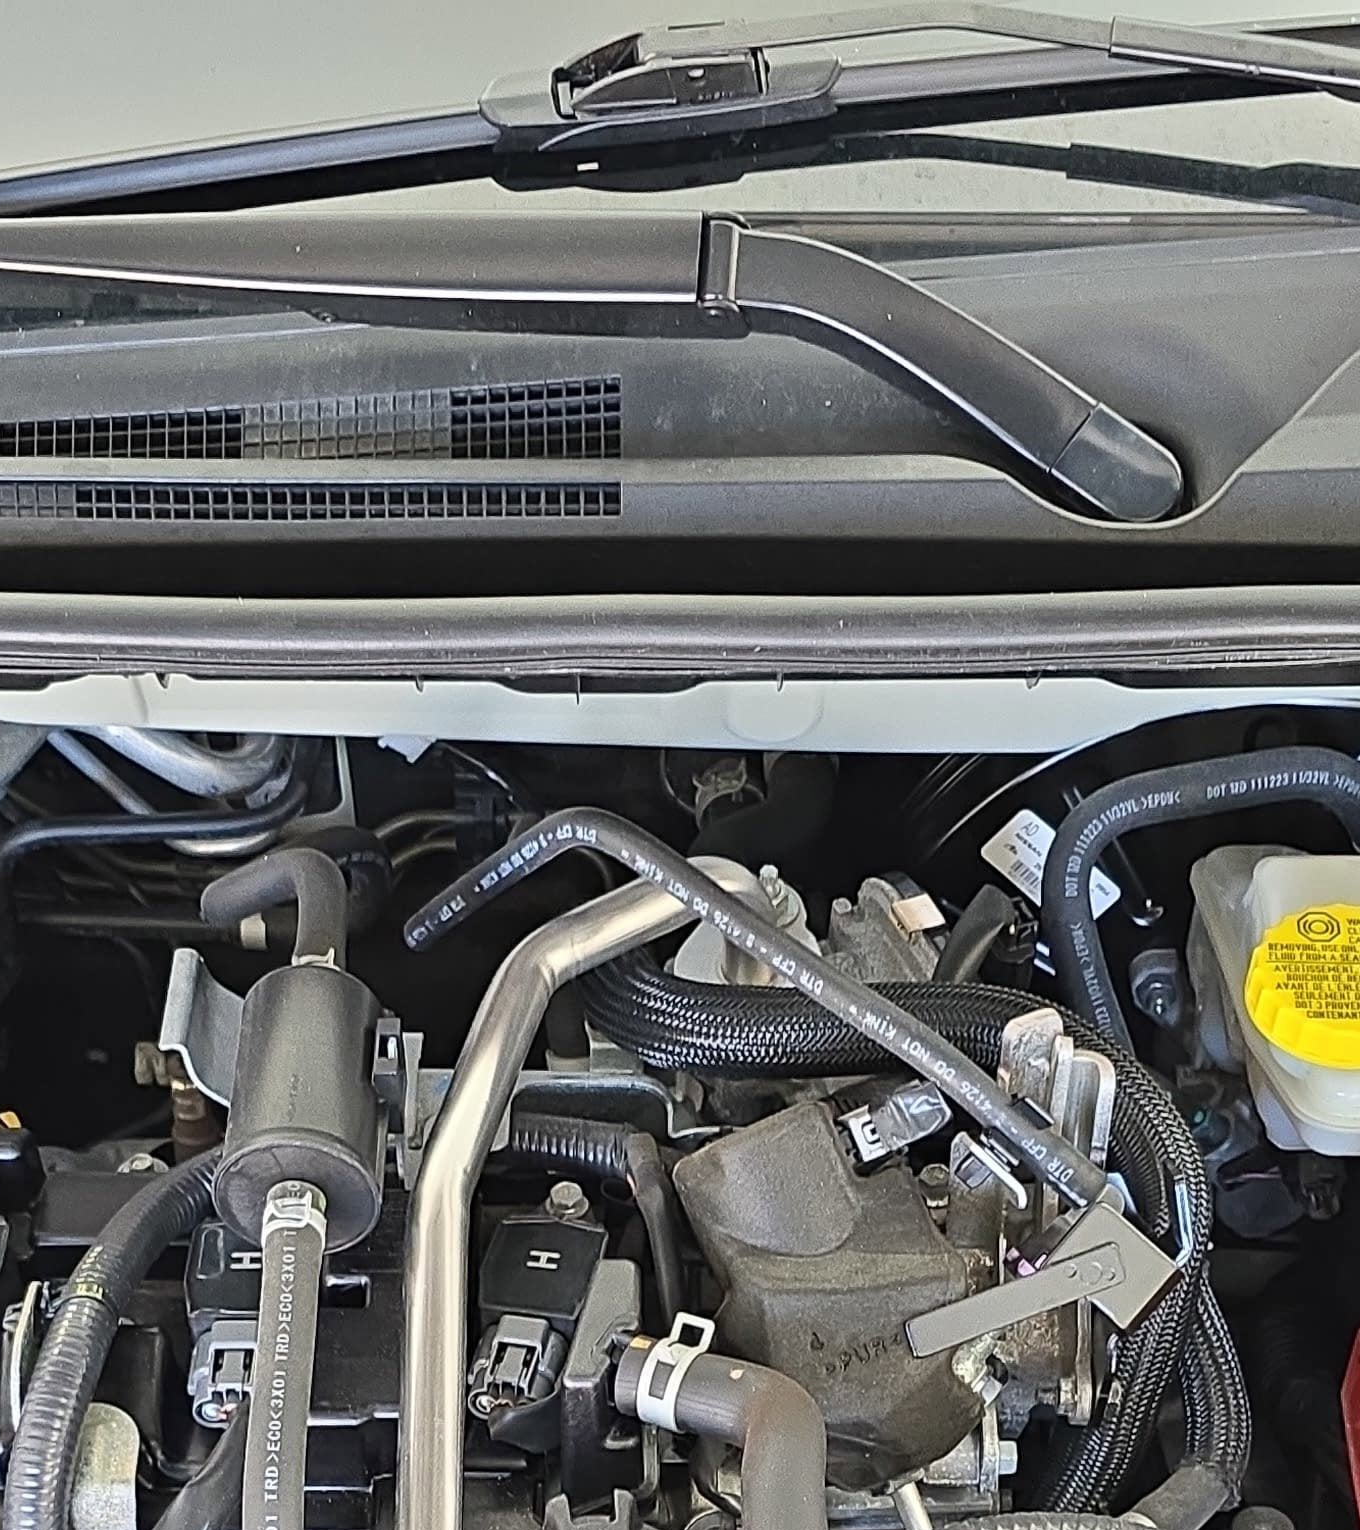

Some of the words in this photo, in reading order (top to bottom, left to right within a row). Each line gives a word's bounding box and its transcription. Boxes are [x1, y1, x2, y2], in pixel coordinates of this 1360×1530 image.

[1268, 951, 1297, 961] FLUID
[1299, 952, 1327, 961] FROM
[1286, 973, 1329, 982] BOUCHON
[1275, 982, 1311, 991] AVANT
[1293, 991, 1349, 1001] SEULEMENT
[1295, 1000, 1314, 1010] DOT
[901, 1036, 931, 1063] NOT
[933, 1060, 956, 1082] DO
[1046, 1155, 1075, 1184] DTR
[230, 1252, 262, 1270] H
[526, 1250, 561, 1270] H
